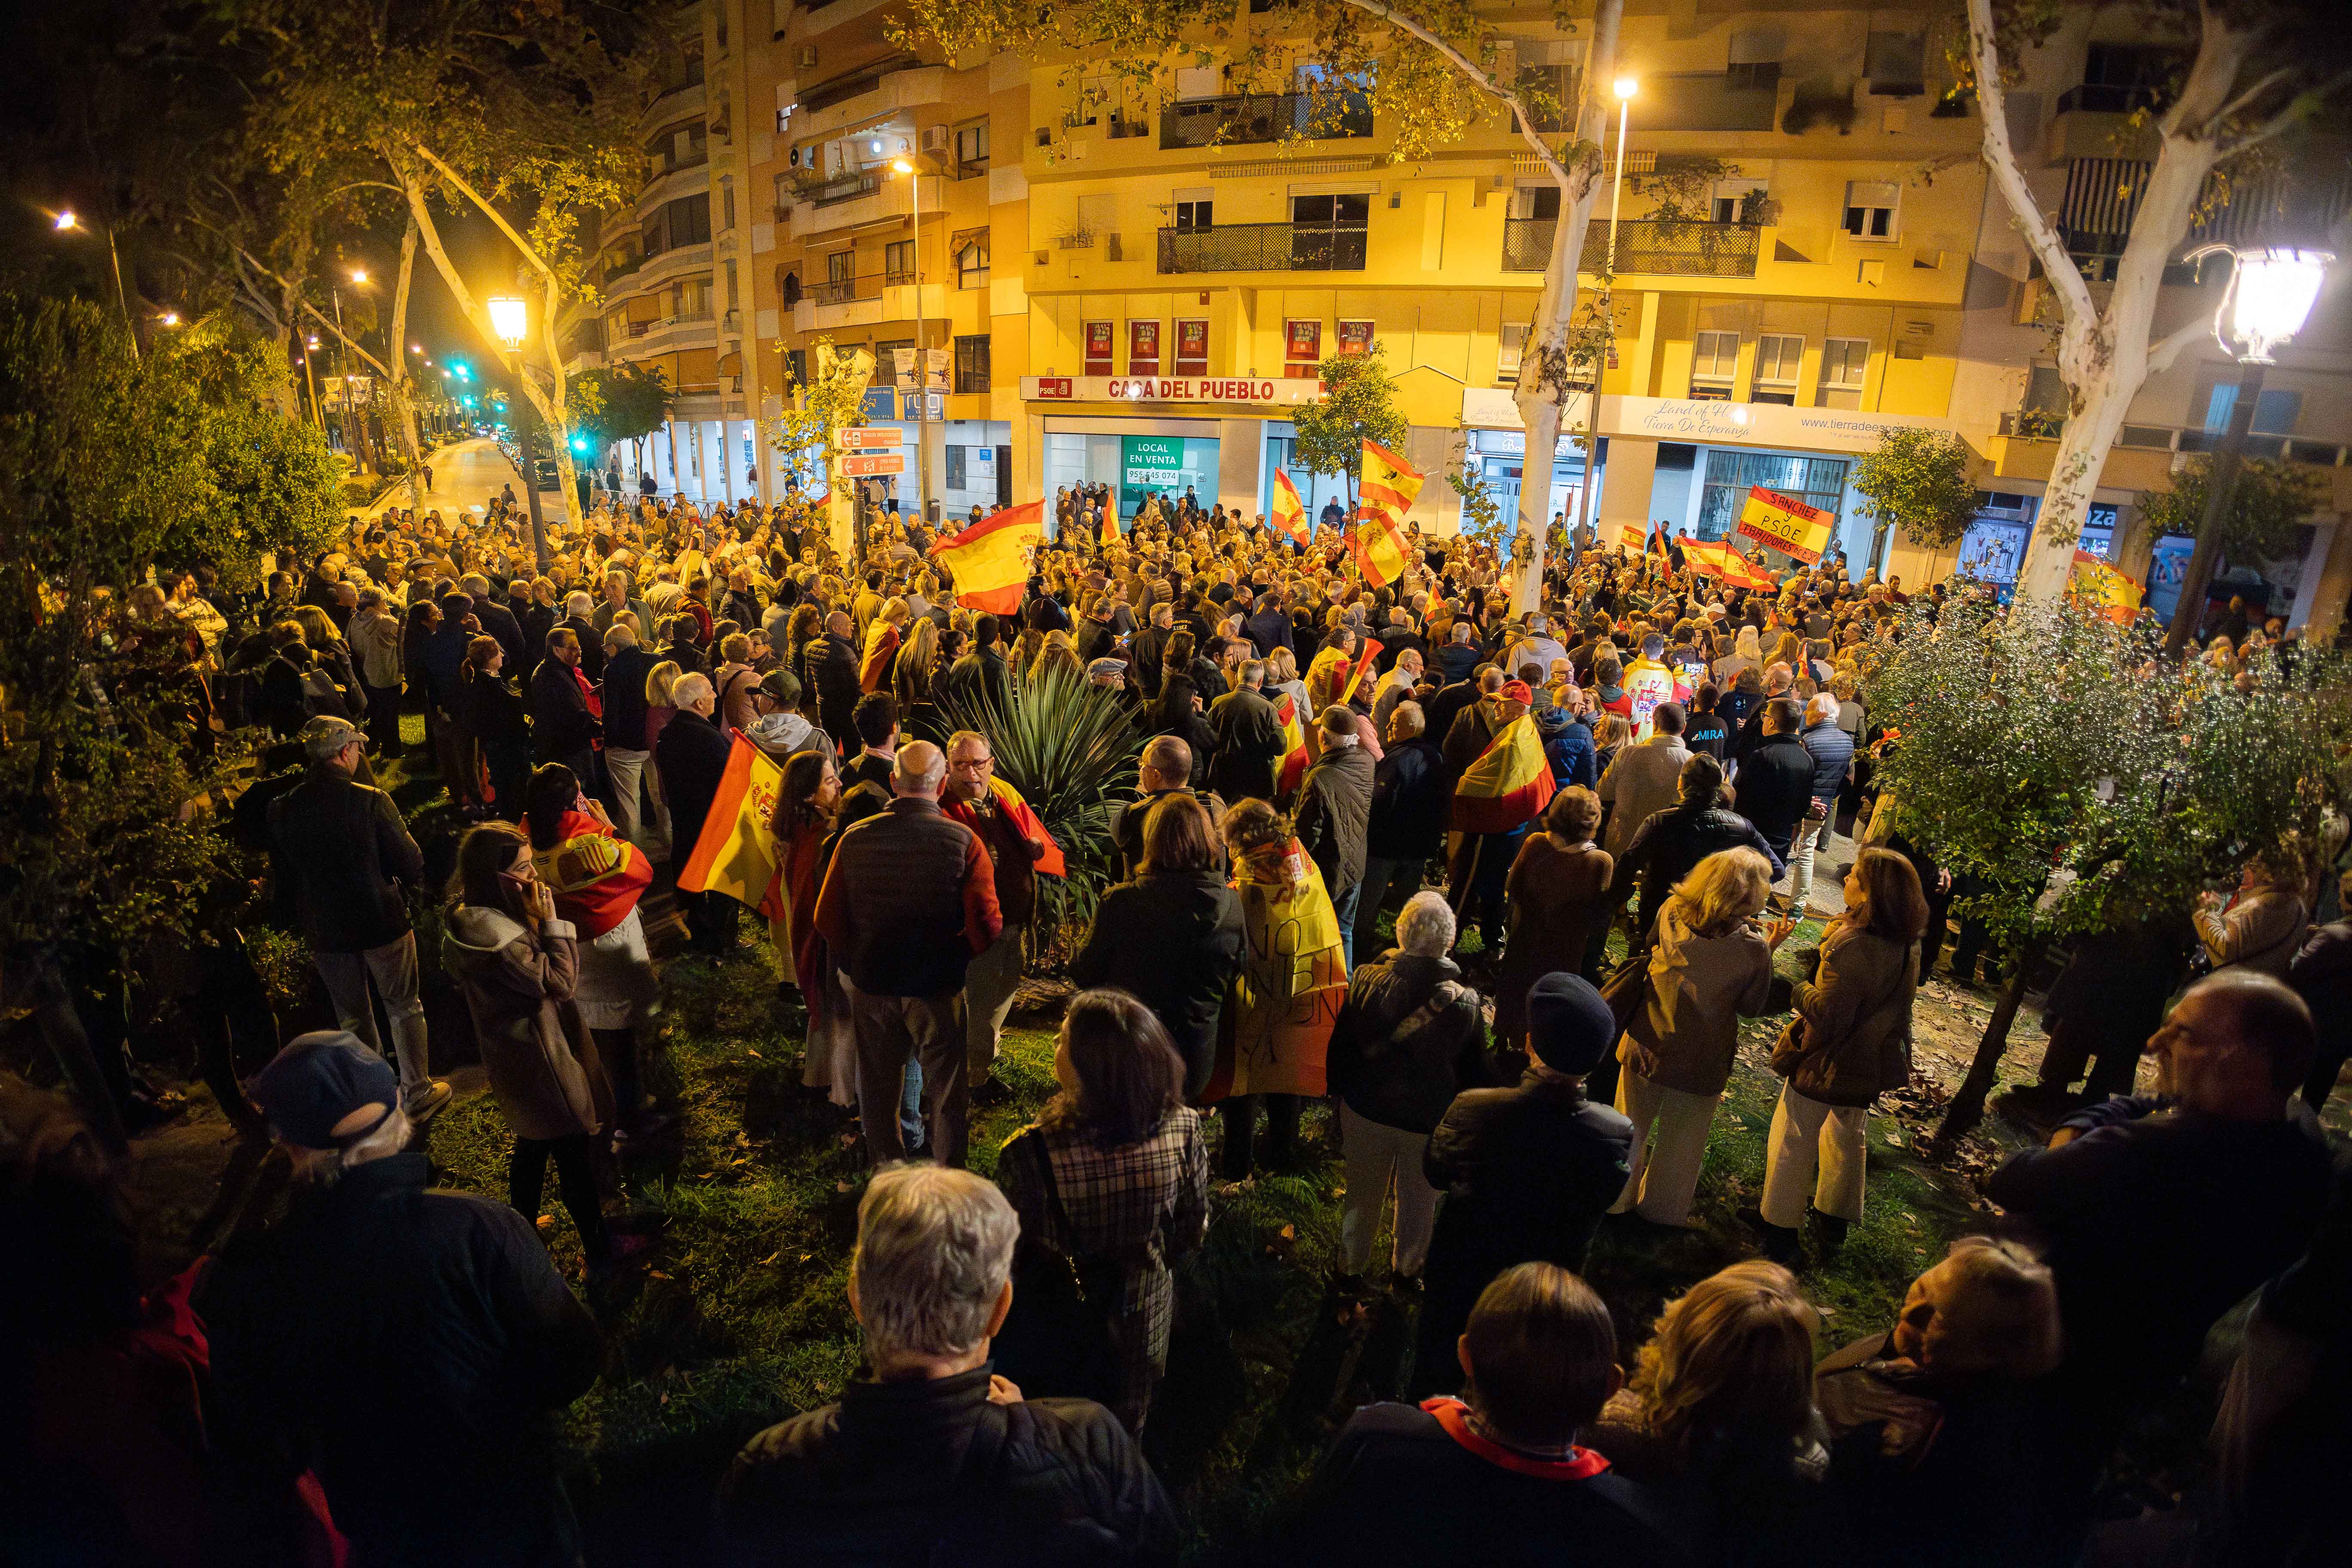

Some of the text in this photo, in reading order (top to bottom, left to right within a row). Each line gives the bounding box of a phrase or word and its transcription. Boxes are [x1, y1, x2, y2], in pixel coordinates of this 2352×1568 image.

[1109, 380, 1274, 400] CASA DEL PUEBLO
[1655, 400, 1696, 415] Land
[1696, 405, 1709, 420] of
[1645, 416, 1751, 438] Tierra De Esperanza
[1138, 443, 1168, 453] LOCAL
[1130, 454, 1176, 465] EN VENTA
[1770, 493, 1819, 520] SANCHEZ
[1743, 524, 1795, 552] TRAIDORES
[1761, 515, 1801, 542] P.S.O.E.
